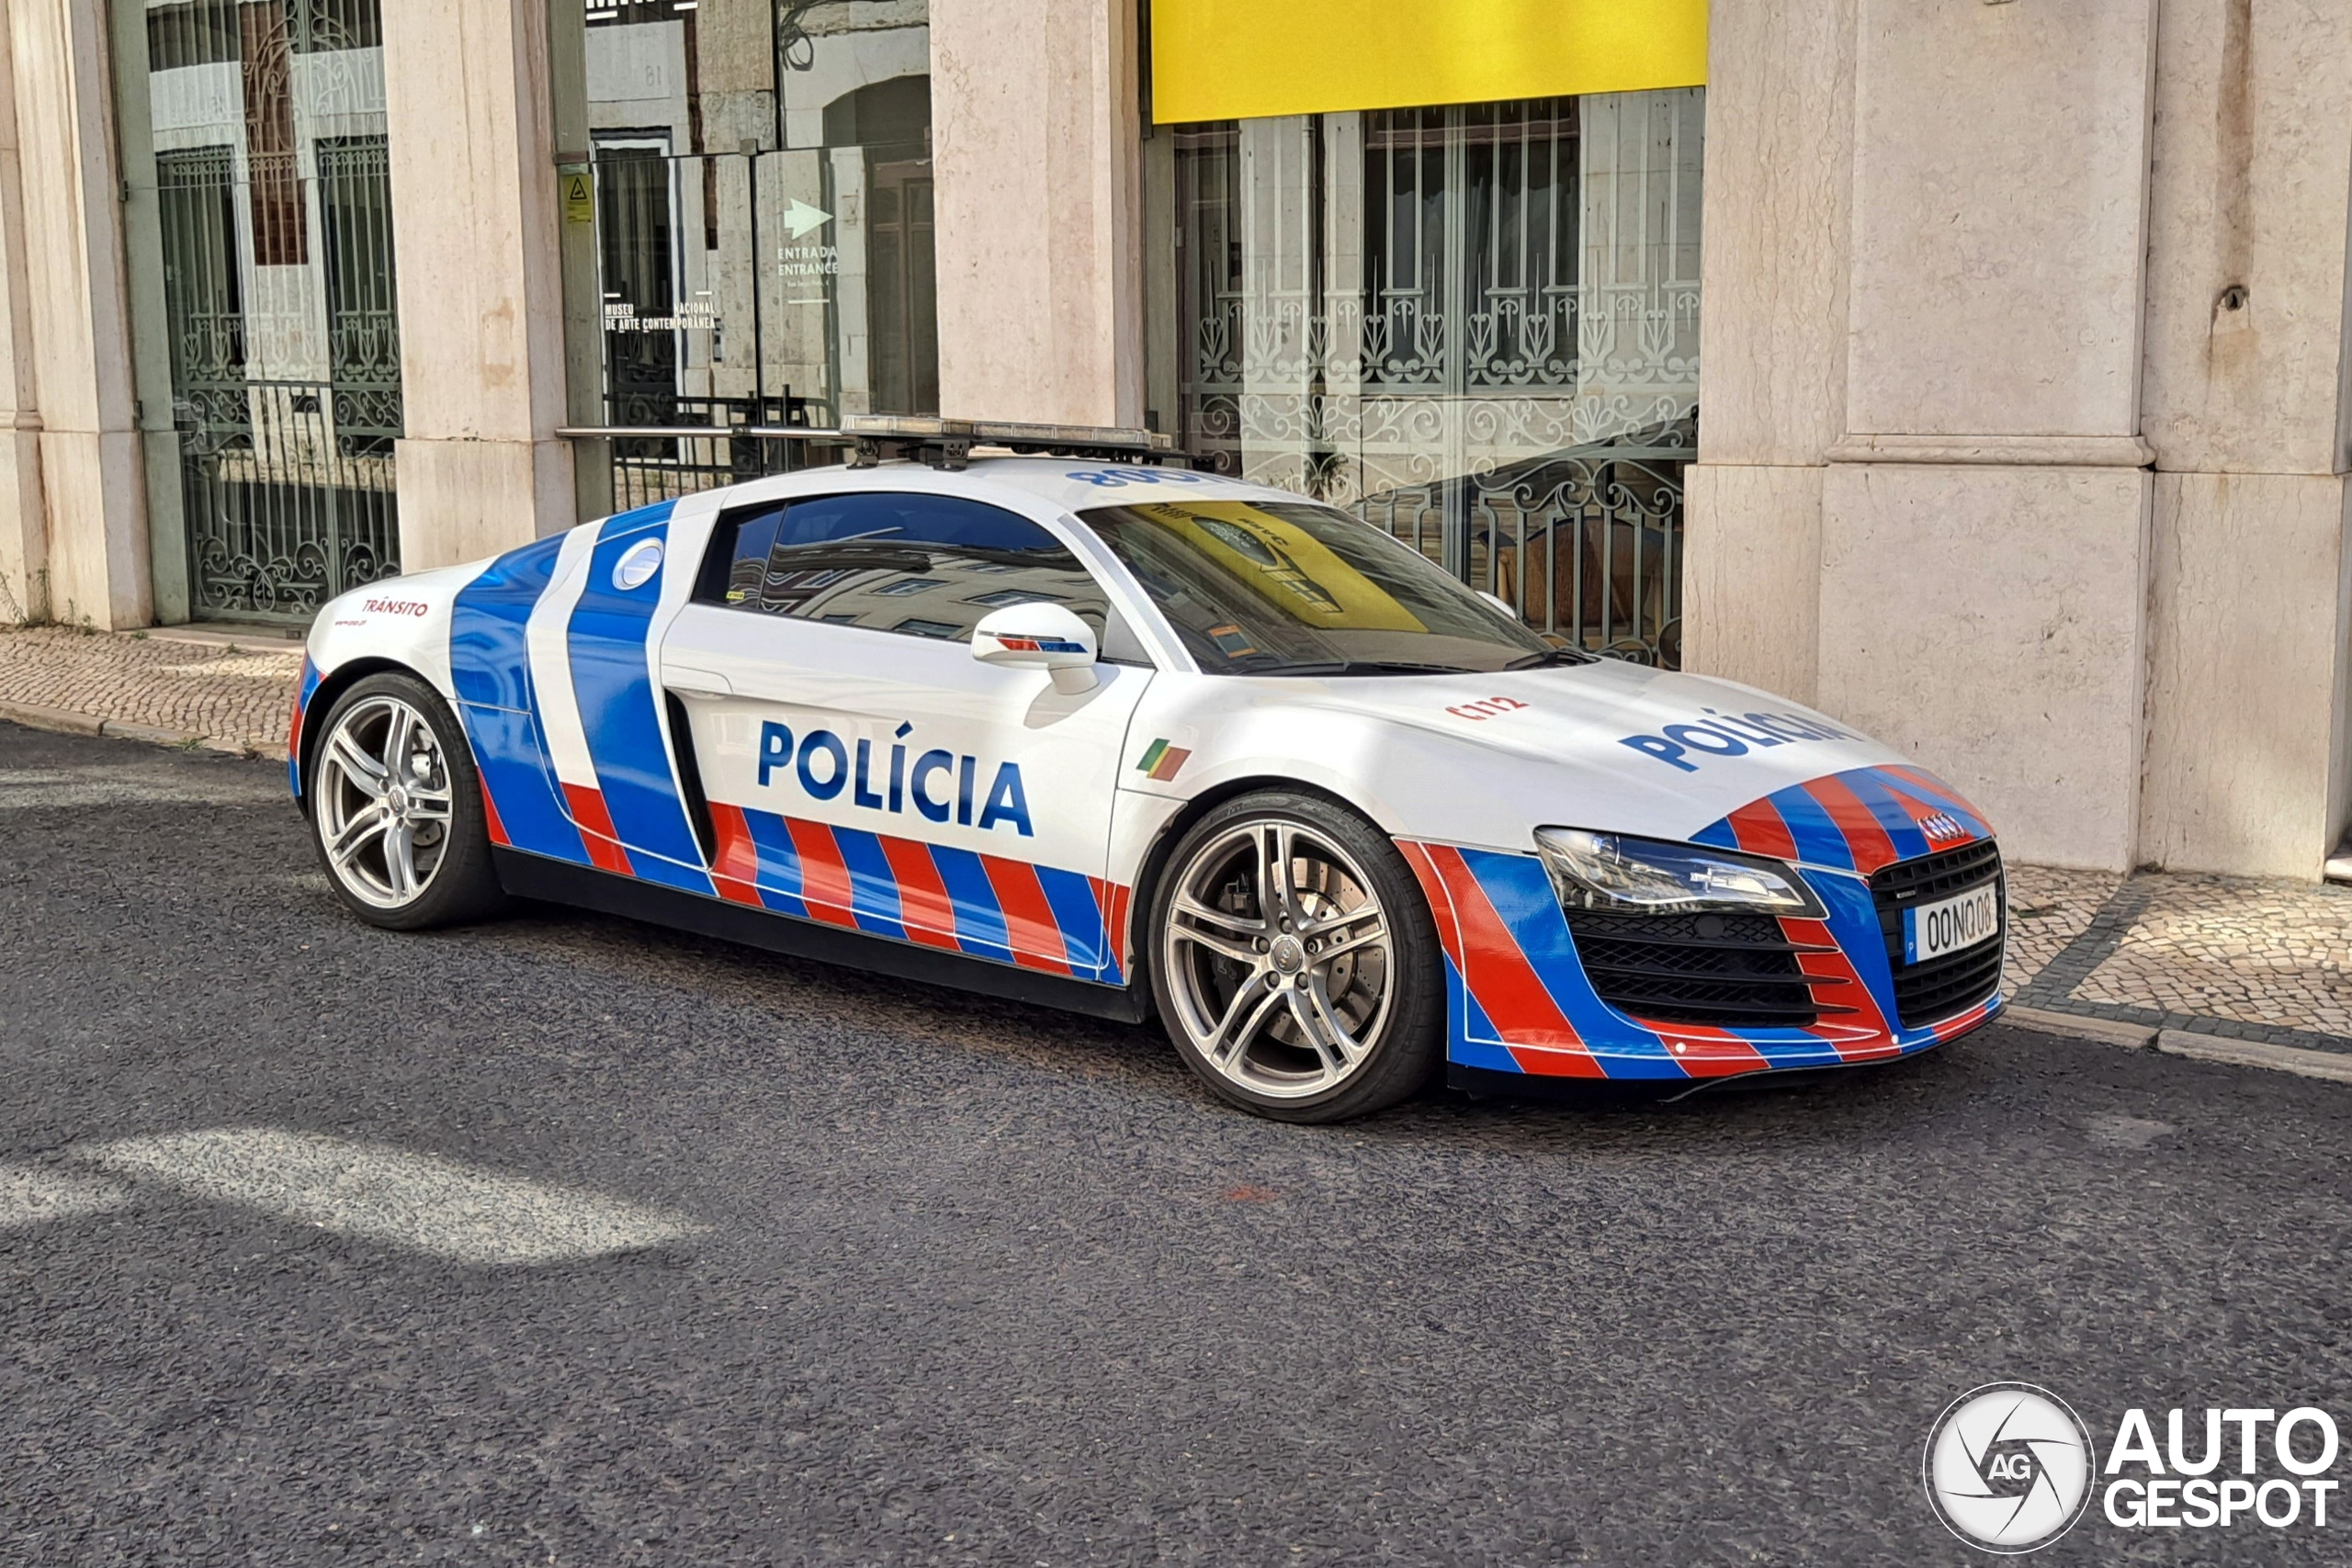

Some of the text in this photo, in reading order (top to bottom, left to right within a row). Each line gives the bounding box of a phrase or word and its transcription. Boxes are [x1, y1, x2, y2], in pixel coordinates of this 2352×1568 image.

[777, 245, 838, 260] ENTRADA
[778, 262, 839, 276] ENTRANCE
[605, 301, 716, 316] MUSEU NACIONAL
[605, 315, 716, 331] DE ARTE CONTEMPORÂNEA
[362, 596, 428, 617] TRÂNSITO
[1617, 706, 1866, 773] POLÍCIA
[758, 720, 1035, 838] POLÍCIA
[1907, 942, 1915, 954] P
